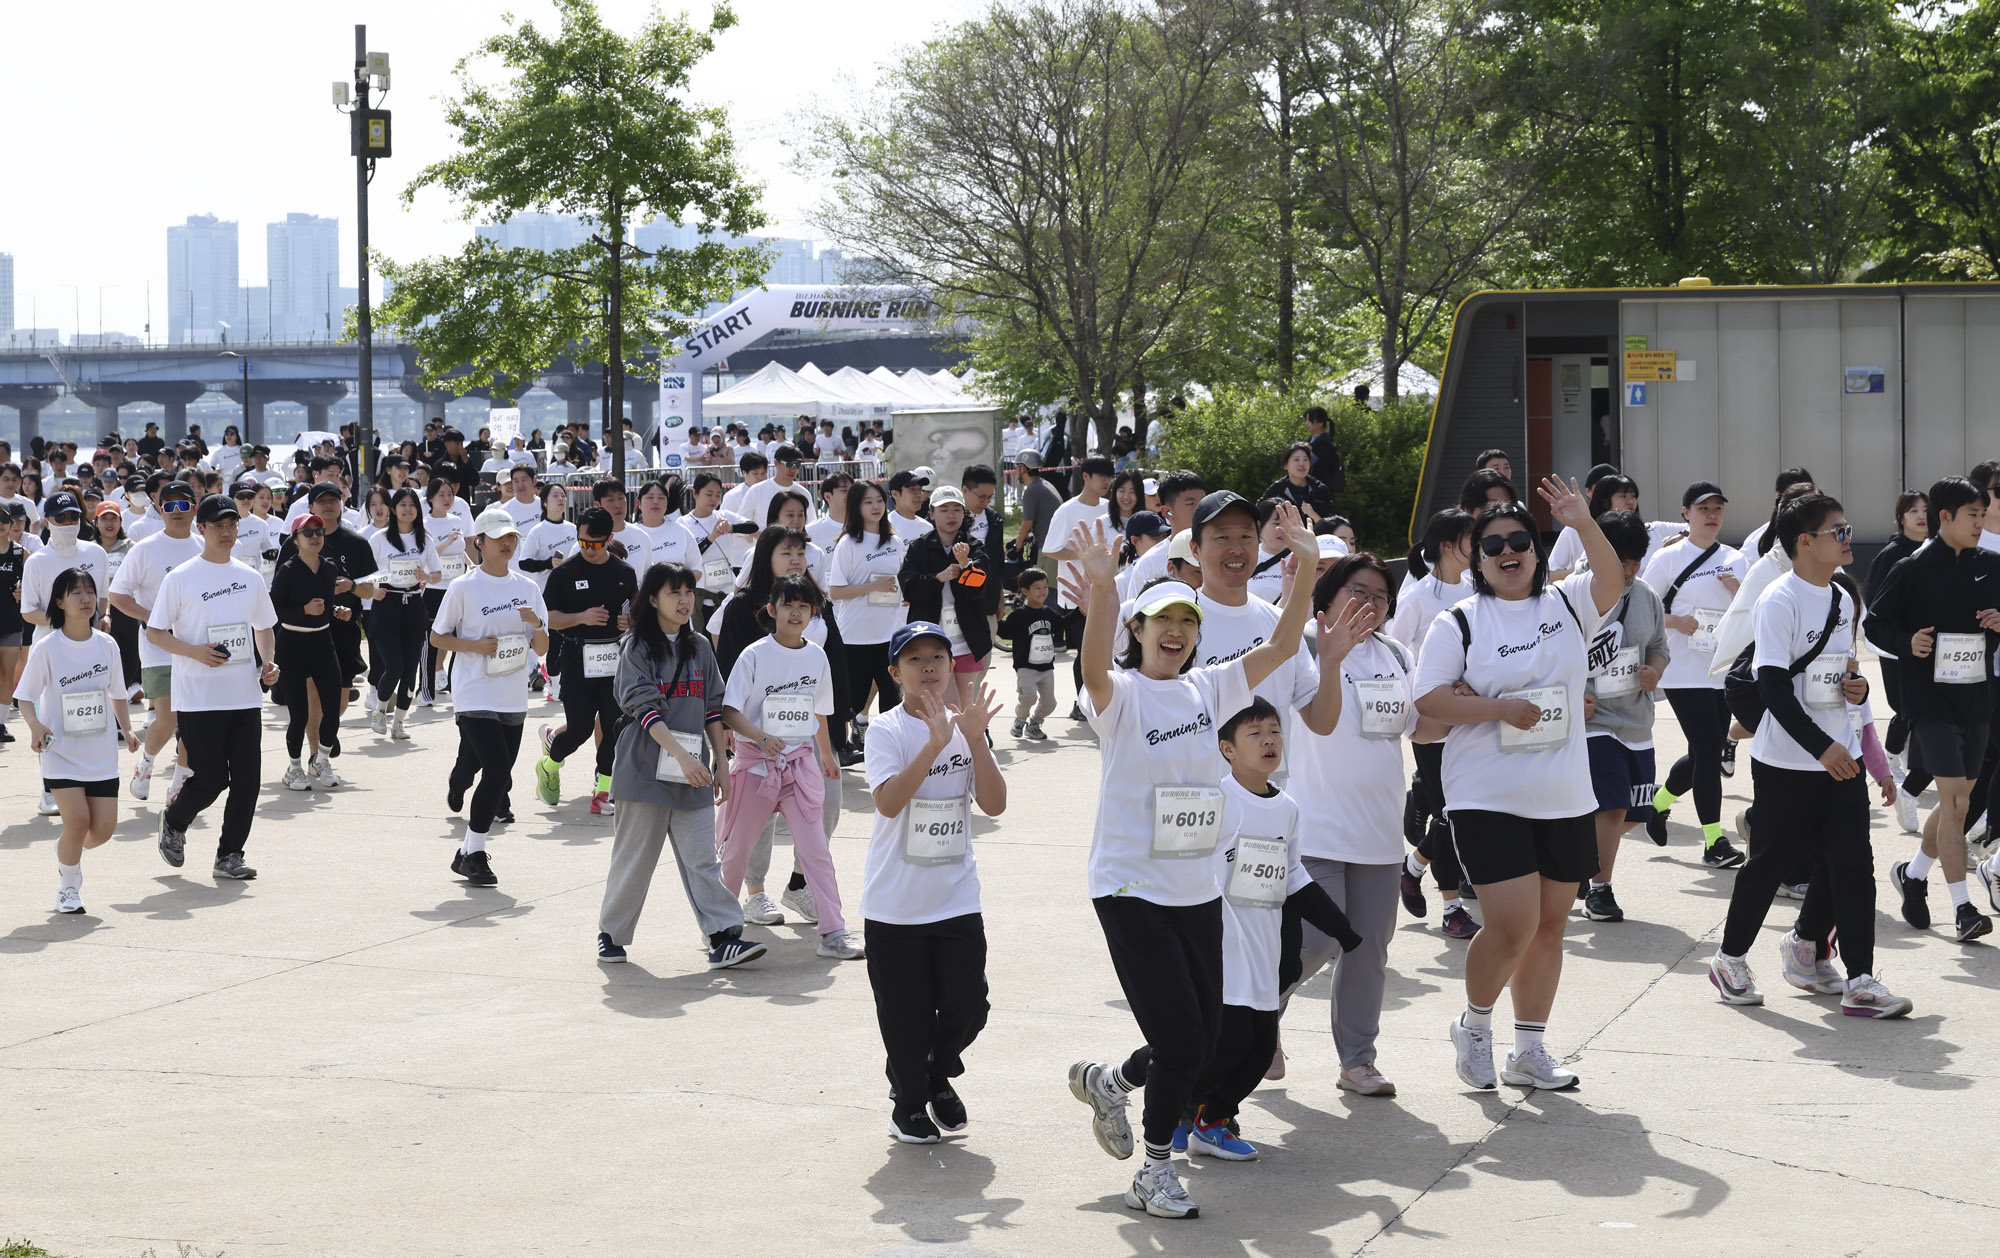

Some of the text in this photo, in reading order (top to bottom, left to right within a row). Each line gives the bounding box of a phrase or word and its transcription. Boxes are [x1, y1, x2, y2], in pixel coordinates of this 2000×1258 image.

[790, 301, 931, 319] BURNING RUN
[685, 306, 753, 358] START
[548, 539, 567, 550] Burning
[627, 544, 641, 552] Run
[388, 550, 410, 560] Burning
[865, 546, 897, 562] Burning Run
[398, 568, 415, 576] 620
[713, 568, 729, 577] 6362
[1715, 565, 1734, 573] Run
[201, 582, 247, 602] Burning Run
[481, 597, 528, 616] Burning Run
[222, 637, 246, 648] 5107
[1497, 620, 1563, 658] Burning Run
[498, 646, 524, 660] 6280
[596, 652, 618, 662] 5062
[1942, 650, 1984, 662] M 5207
[59, 663, 108, 688] Burning Run
[1611, 663, 1638, 677] 5136
[1811, 674, 1822, 682] M
[765, 680, 799, 696] Burning
[76, 705, 104, 717] 6218
[1365, 700, 1405, 714] W 6031
[778, 710, 809, 721] 6068
[1145, 720, 1198, 746] Burning
[1160, 790, 1190, 798] BURNING
[1630, 783, 1654, 807] NIK
[915, 801, 954, 809] BURNING RUN
[1161, 810, 1216, 827] W 6013
[915, 820, 963, 836] W 6012
[1243, 842, 1270, 850] BURNING
[1240, 863, 1286, 880] M 5013
